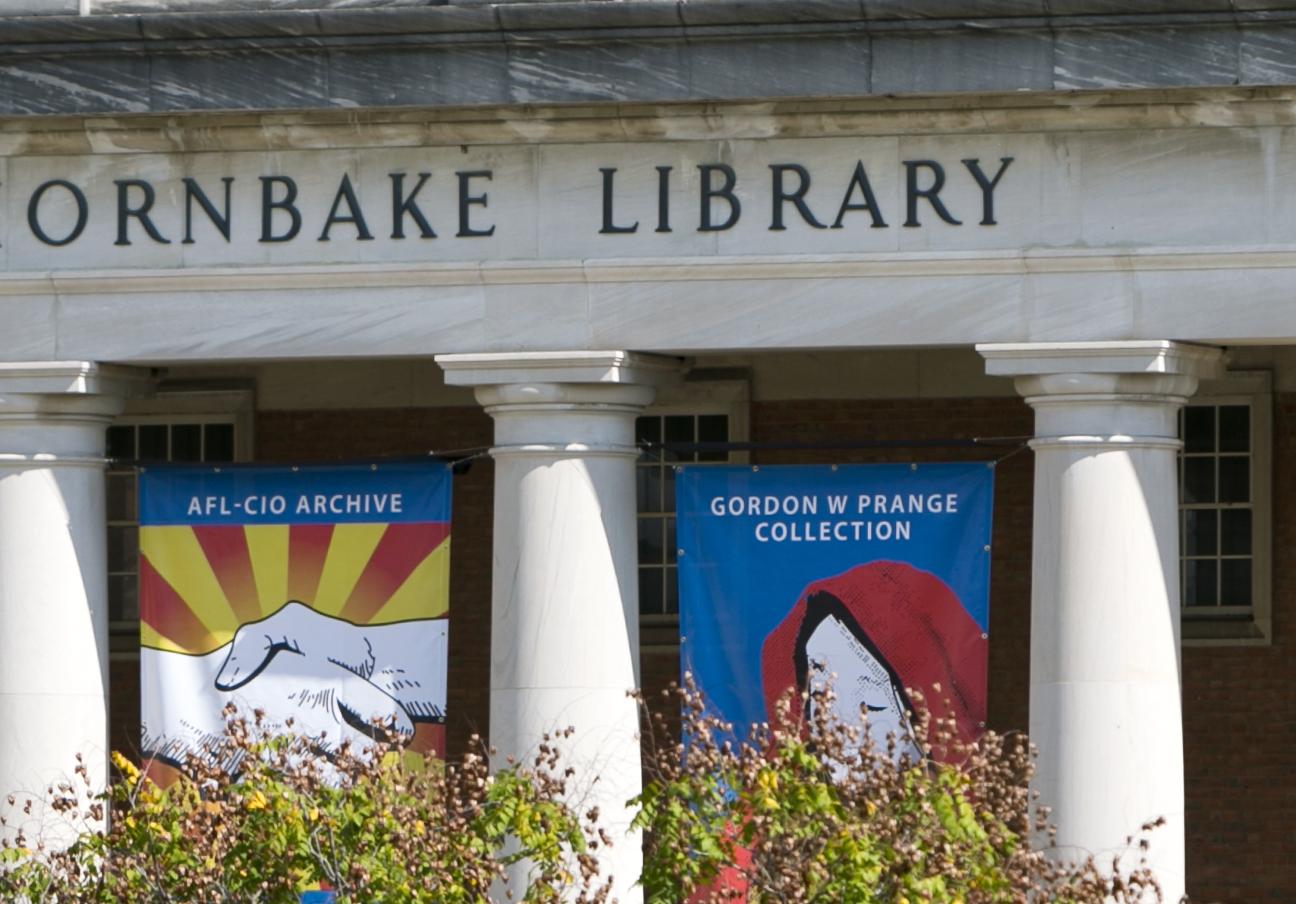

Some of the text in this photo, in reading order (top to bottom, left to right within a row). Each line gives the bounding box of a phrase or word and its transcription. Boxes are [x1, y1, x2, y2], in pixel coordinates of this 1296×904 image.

[599, 157, 1014, 234] LIBRARY
[188, 494, 401, 514] AFL-CIO ARCHIVE
[711, 494, 957, 515] GORDON W PRANGE
[756, 521, 909, 541] COLLECTION
